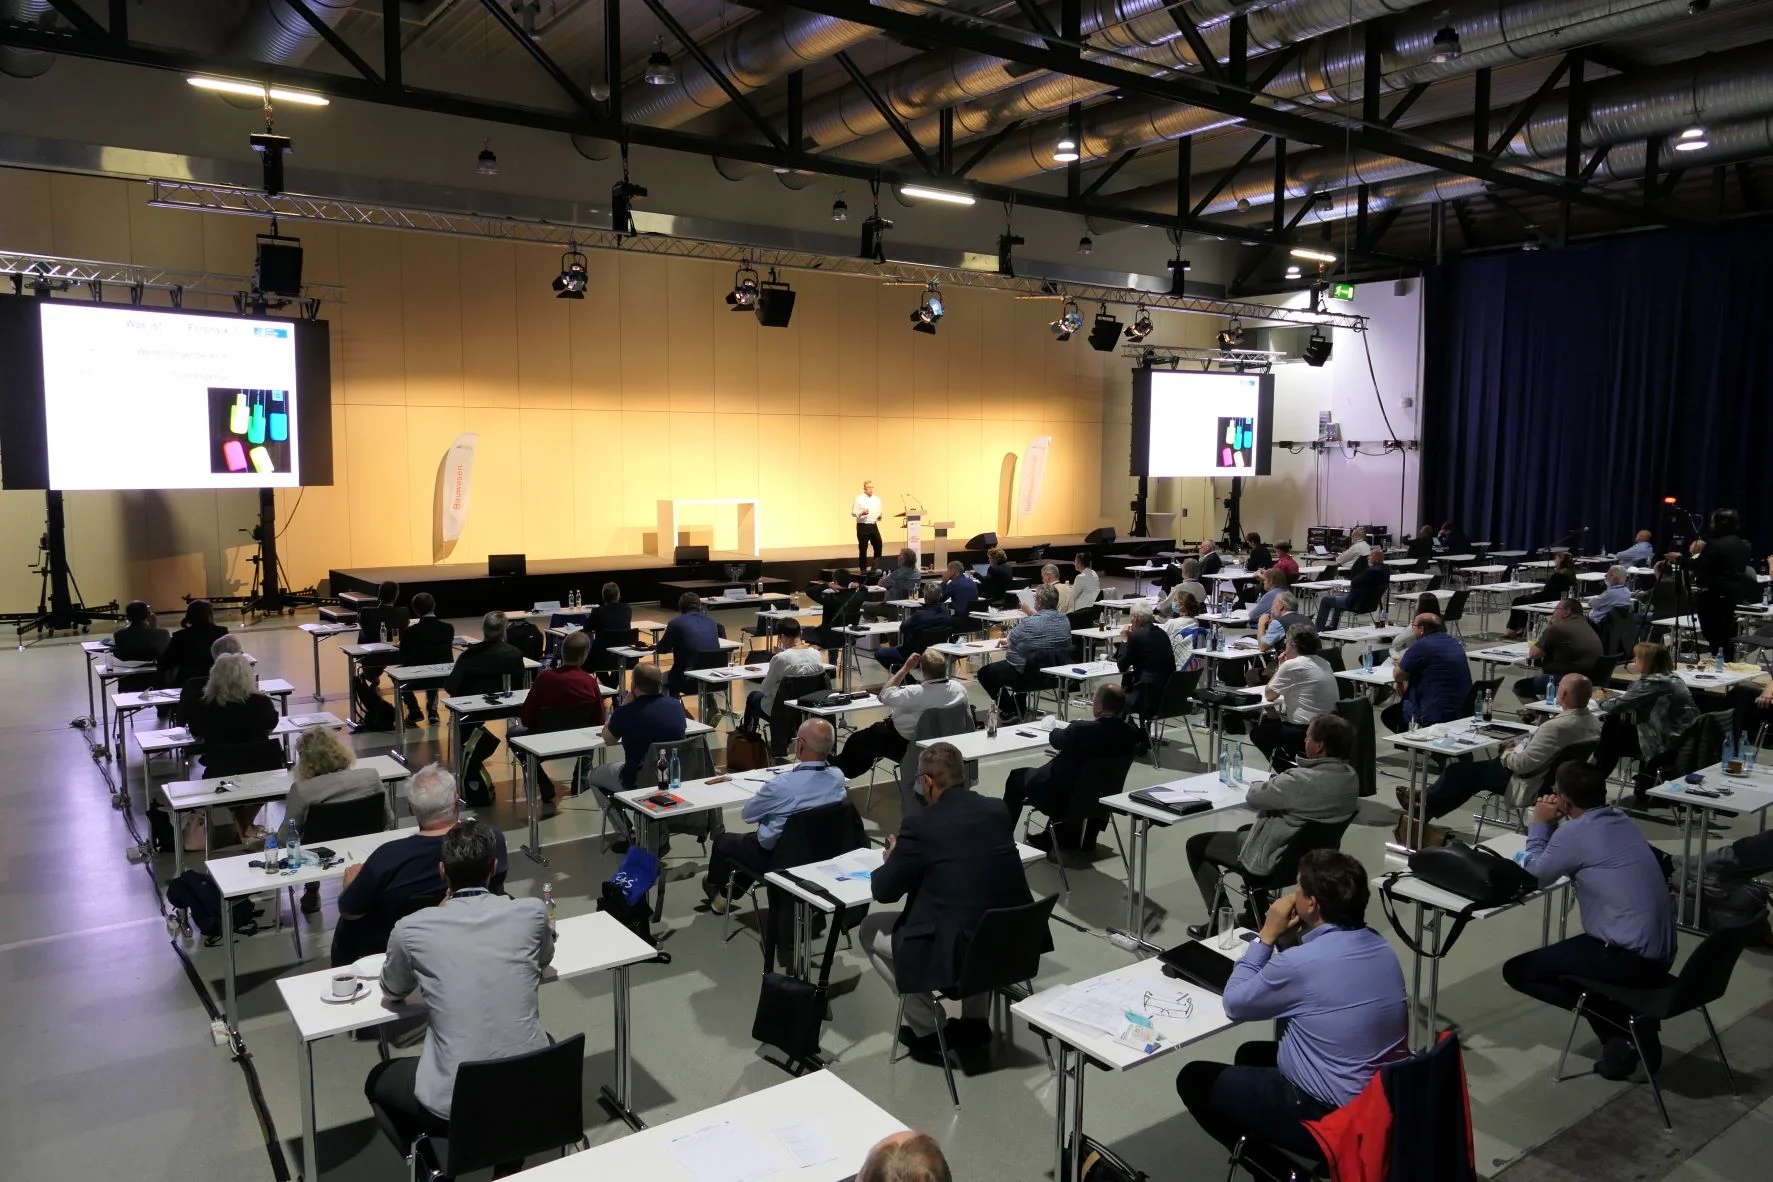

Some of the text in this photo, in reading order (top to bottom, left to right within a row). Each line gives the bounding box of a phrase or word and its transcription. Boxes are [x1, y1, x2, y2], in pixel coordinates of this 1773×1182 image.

[125, 319, 147, 330] Was
[150, 321, 162, 331] ist
[187, 323, 228, 336] Forensik
[452, 465, 464, 510] Bauwesen
